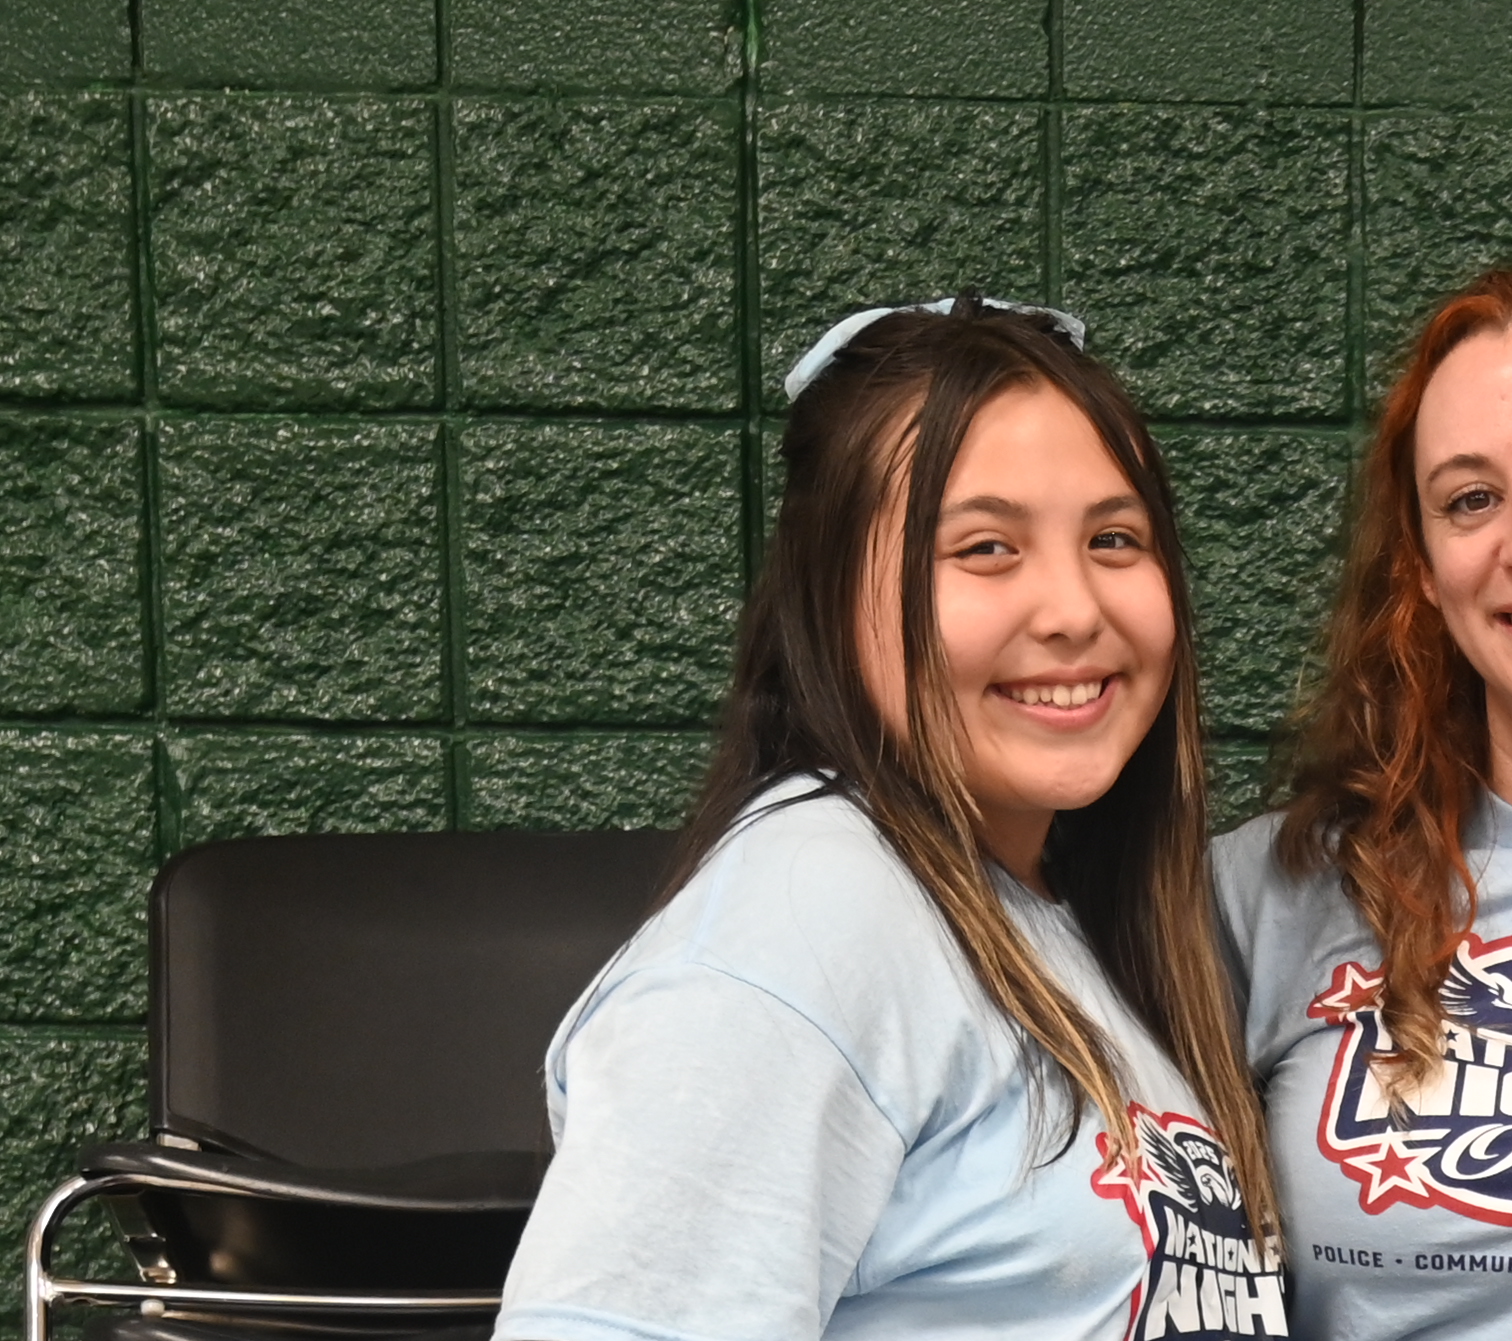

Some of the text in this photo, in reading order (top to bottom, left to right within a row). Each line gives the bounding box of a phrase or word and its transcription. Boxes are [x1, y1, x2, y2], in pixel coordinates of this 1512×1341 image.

[1182, 1140, 1220, 1166] 2025
[1164, 1205, 1284, 1274] NATIONA
[1312, 1244, 1384, 1269] POLICE
[1144, 1261, 1288, 1341] NIGH
